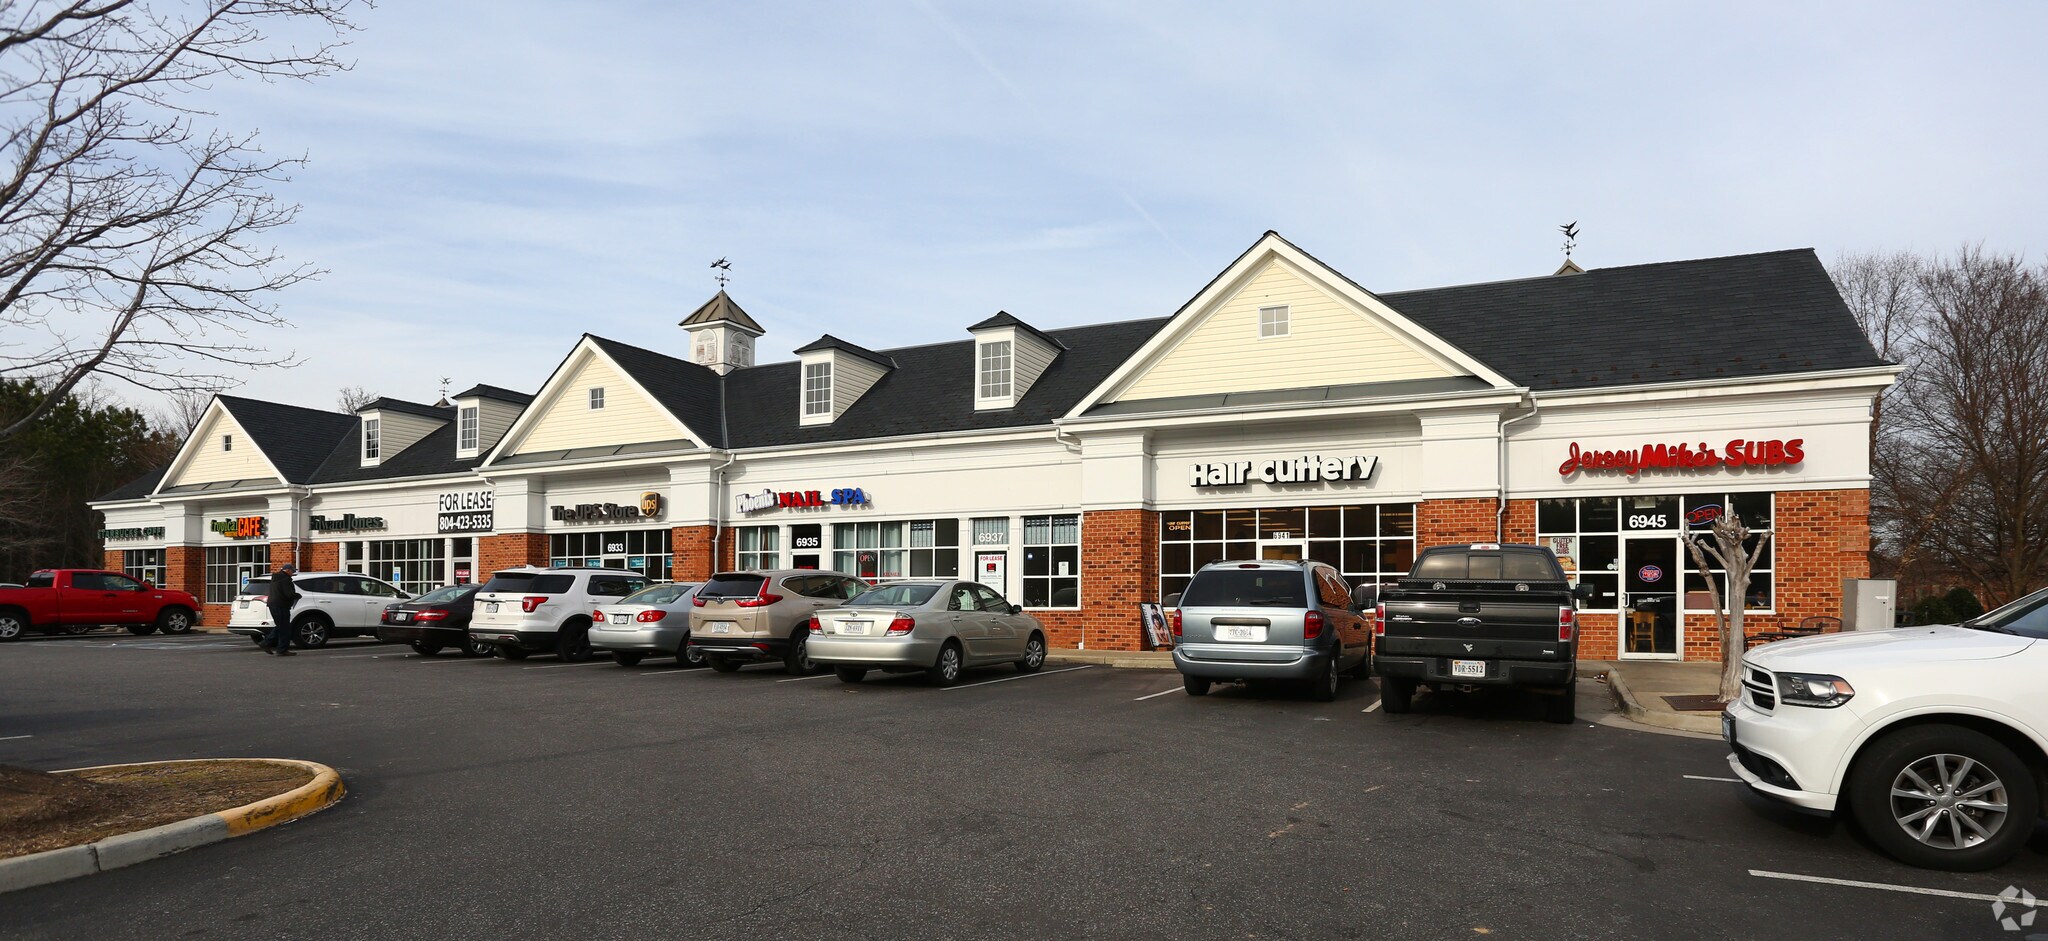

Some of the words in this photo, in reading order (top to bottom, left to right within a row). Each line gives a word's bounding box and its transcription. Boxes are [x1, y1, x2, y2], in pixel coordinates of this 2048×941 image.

[1559, 442, 1638, 475] Jersey
[1640, 443, 1722, 468] Mike's
[1725, 439, 1805, 466] SUBS
[1189, 460, 1251, 487] Hair
[439, 493, 459, 511] FOR
[461, 490, 493, 510] LEASE
[641, 499, 656, 515] ups
[736, 488, 778, 513] Phoenix
[778, 490, 823, 508] NAIL
[831, 488, 866, 505] SPA
[551, 505, 576, 520] The
[575, 503, 602, 519] UPS
[602, 502, 639, 518] Store
[1686, 507, 1723, 523] OPEN
[238, 516, 262, 537] CAFE
[310, 514, 344, 531] Edward
[344, 513, 384, 531] Jones
[439, 513, 492, 531] 804-423-5335
[1628, 514, 1667, 529] 6945
[97, 527, 142, 539] STARBUCKS
[979, 532, 1004, 542] 6937
[1273, 531, 1289, 539] 6941
[607, 543, 624, 553] 6933
[796, 537, 818, 547] 6935
